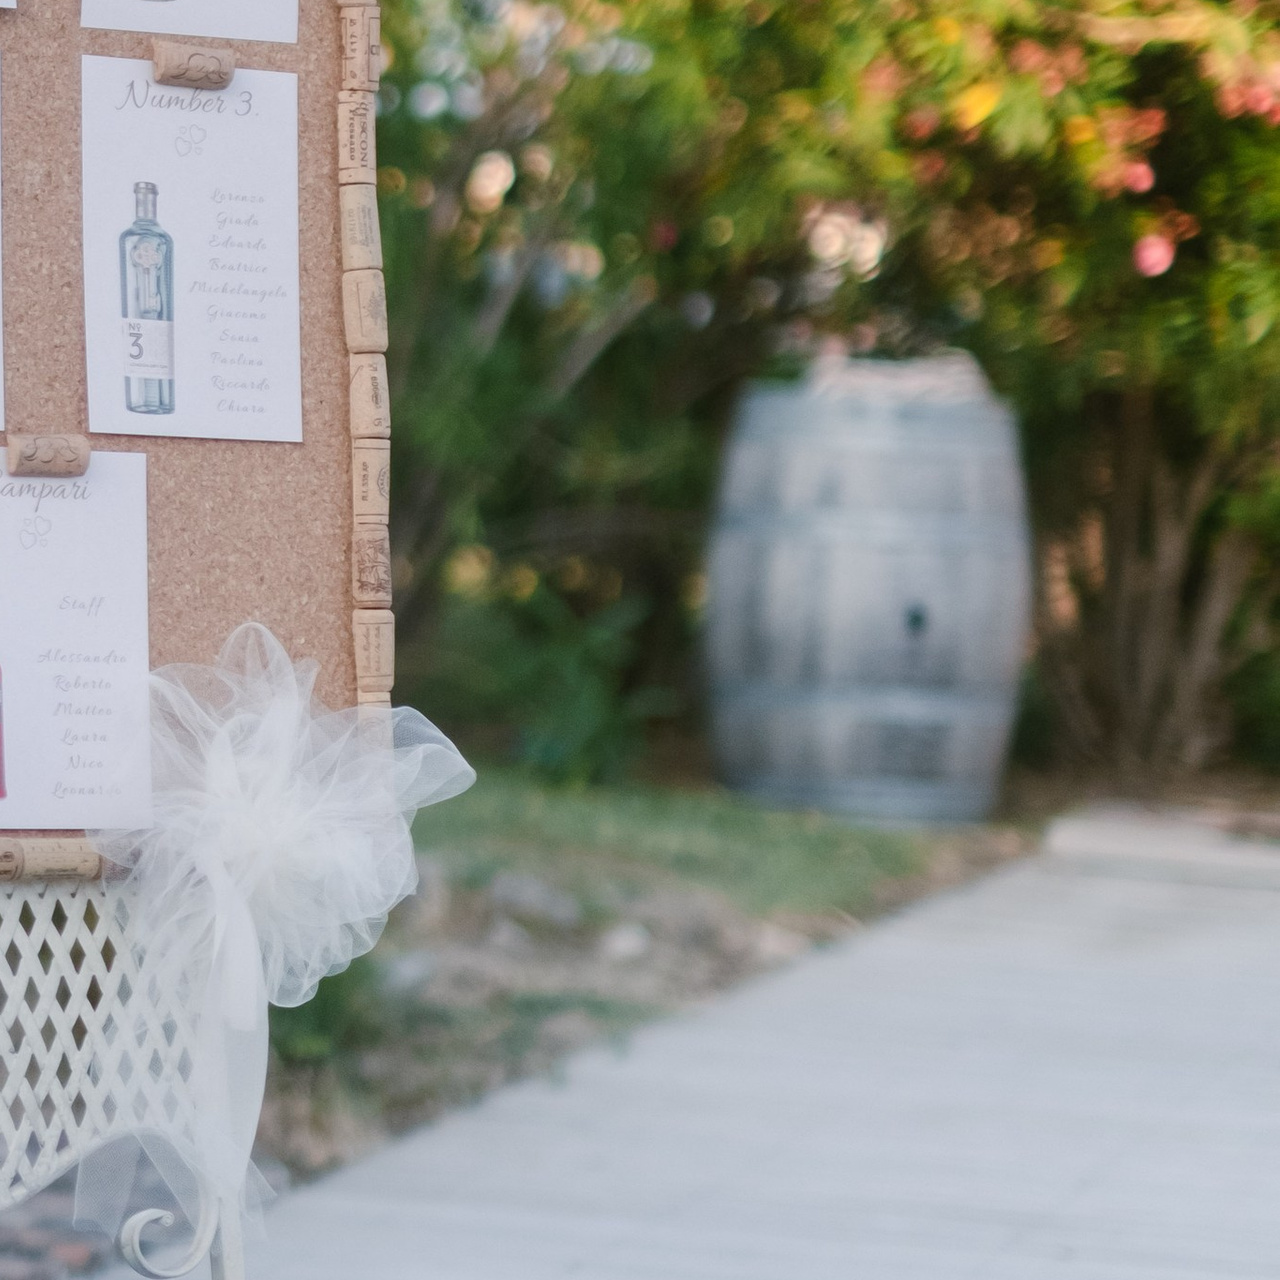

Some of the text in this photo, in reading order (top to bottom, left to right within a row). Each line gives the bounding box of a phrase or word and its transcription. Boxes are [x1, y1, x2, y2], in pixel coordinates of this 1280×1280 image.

[115, 80, 226, 114] Number
[210, 188, 265, 204] Lorenzo
[209, 234, 268, 251] Edoardo
[189, 280, 288, 303] Michelangelo
[129, 332, 144, 360] 3
[211, 375, 271, 391] Riccardo
[217, 399, 265, 414] Chiara
[59, 595, 105, 617] Staff
[37, 648, 128, 665] Alessandro
[52, 674, 113, 692] Roberto
[52, 702, 113, 716] Matteo
[60, 727, 108, 745] Laura
[65, 754, 104, 771] Nico
